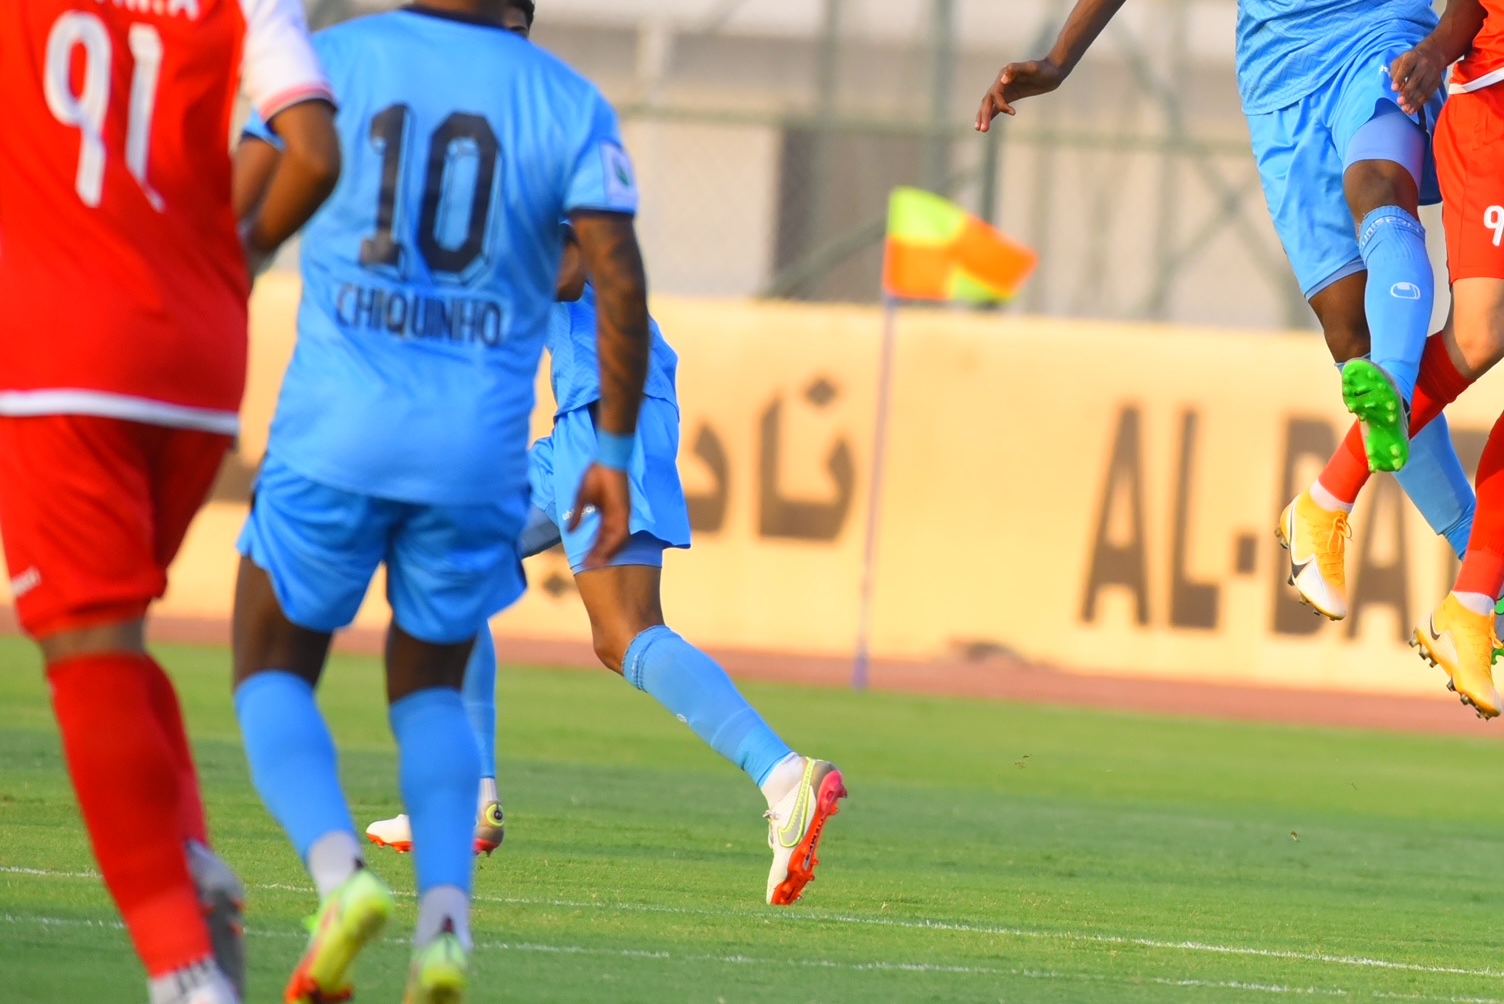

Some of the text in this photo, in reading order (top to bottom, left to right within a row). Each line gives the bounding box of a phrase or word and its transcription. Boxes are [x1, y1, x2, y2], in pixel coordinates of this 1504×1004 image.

[44, 10, 166, 213] 91
[358, 102, 502, 286] 10
[336, 282, 502, 348] CHIQUINHO
